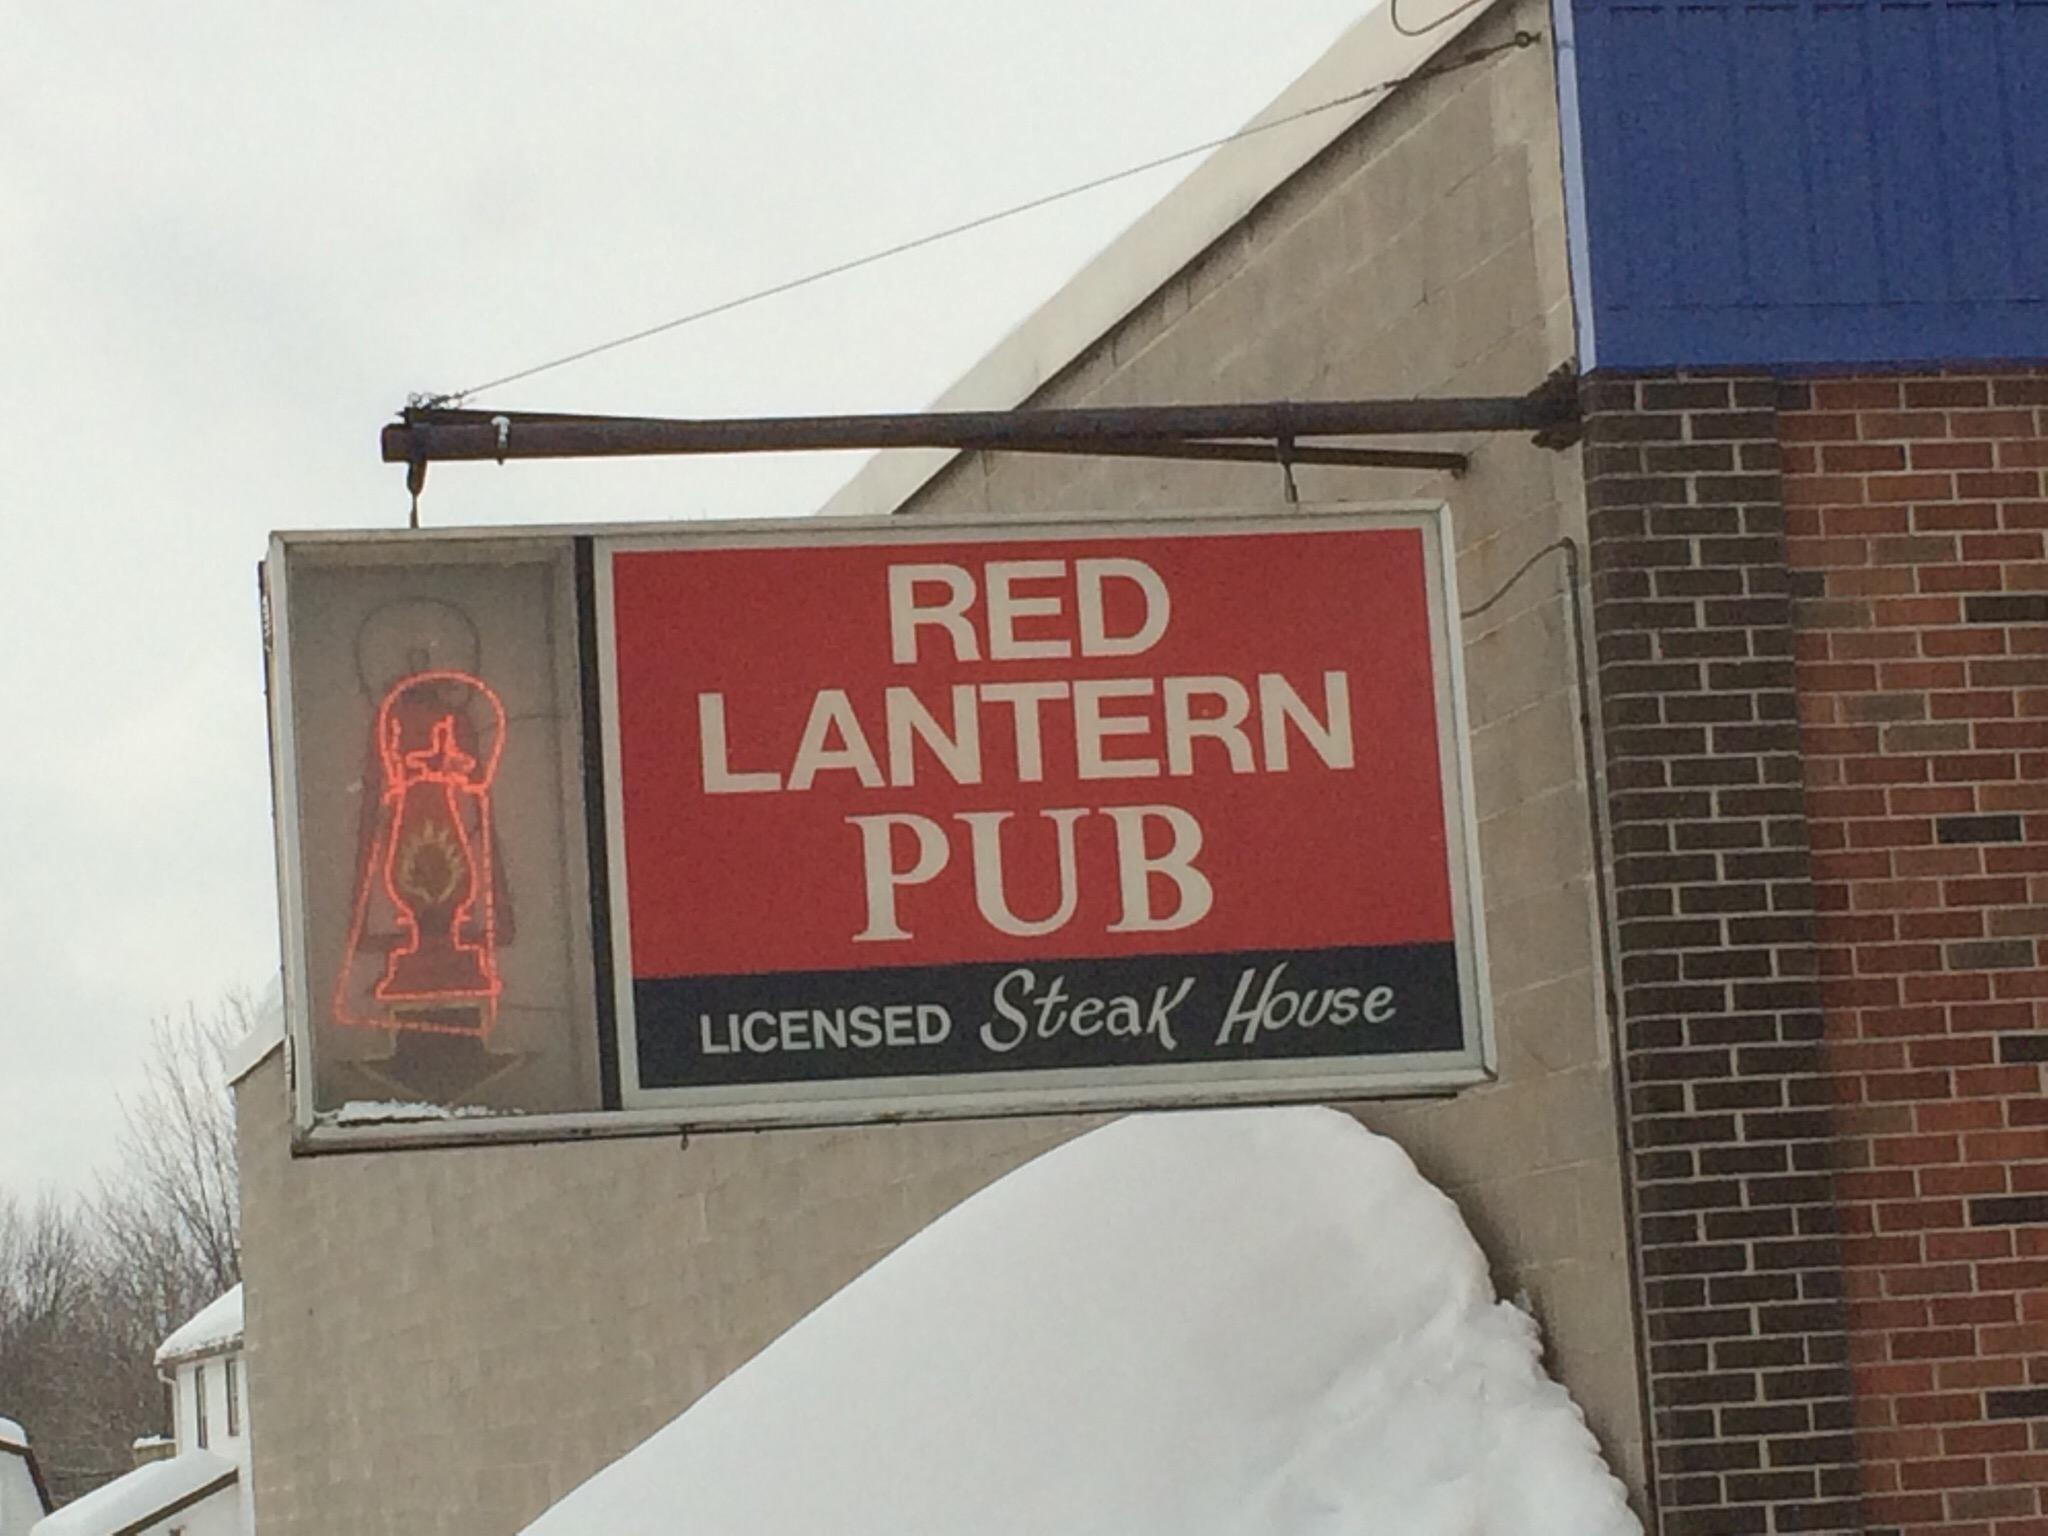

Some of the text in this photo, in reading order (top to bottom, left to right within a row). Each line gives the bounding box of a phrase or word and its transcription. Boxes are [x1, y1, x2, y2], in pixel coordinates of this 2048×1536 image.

[888, 558, 1171, 664] RED
[699, 671, 1355, 795] LANTERN
[846, 804, 1214, 943] PUB
[700, 1005, 951, 1056] LICENSED
[1215, 962, 1397, 1047] House
